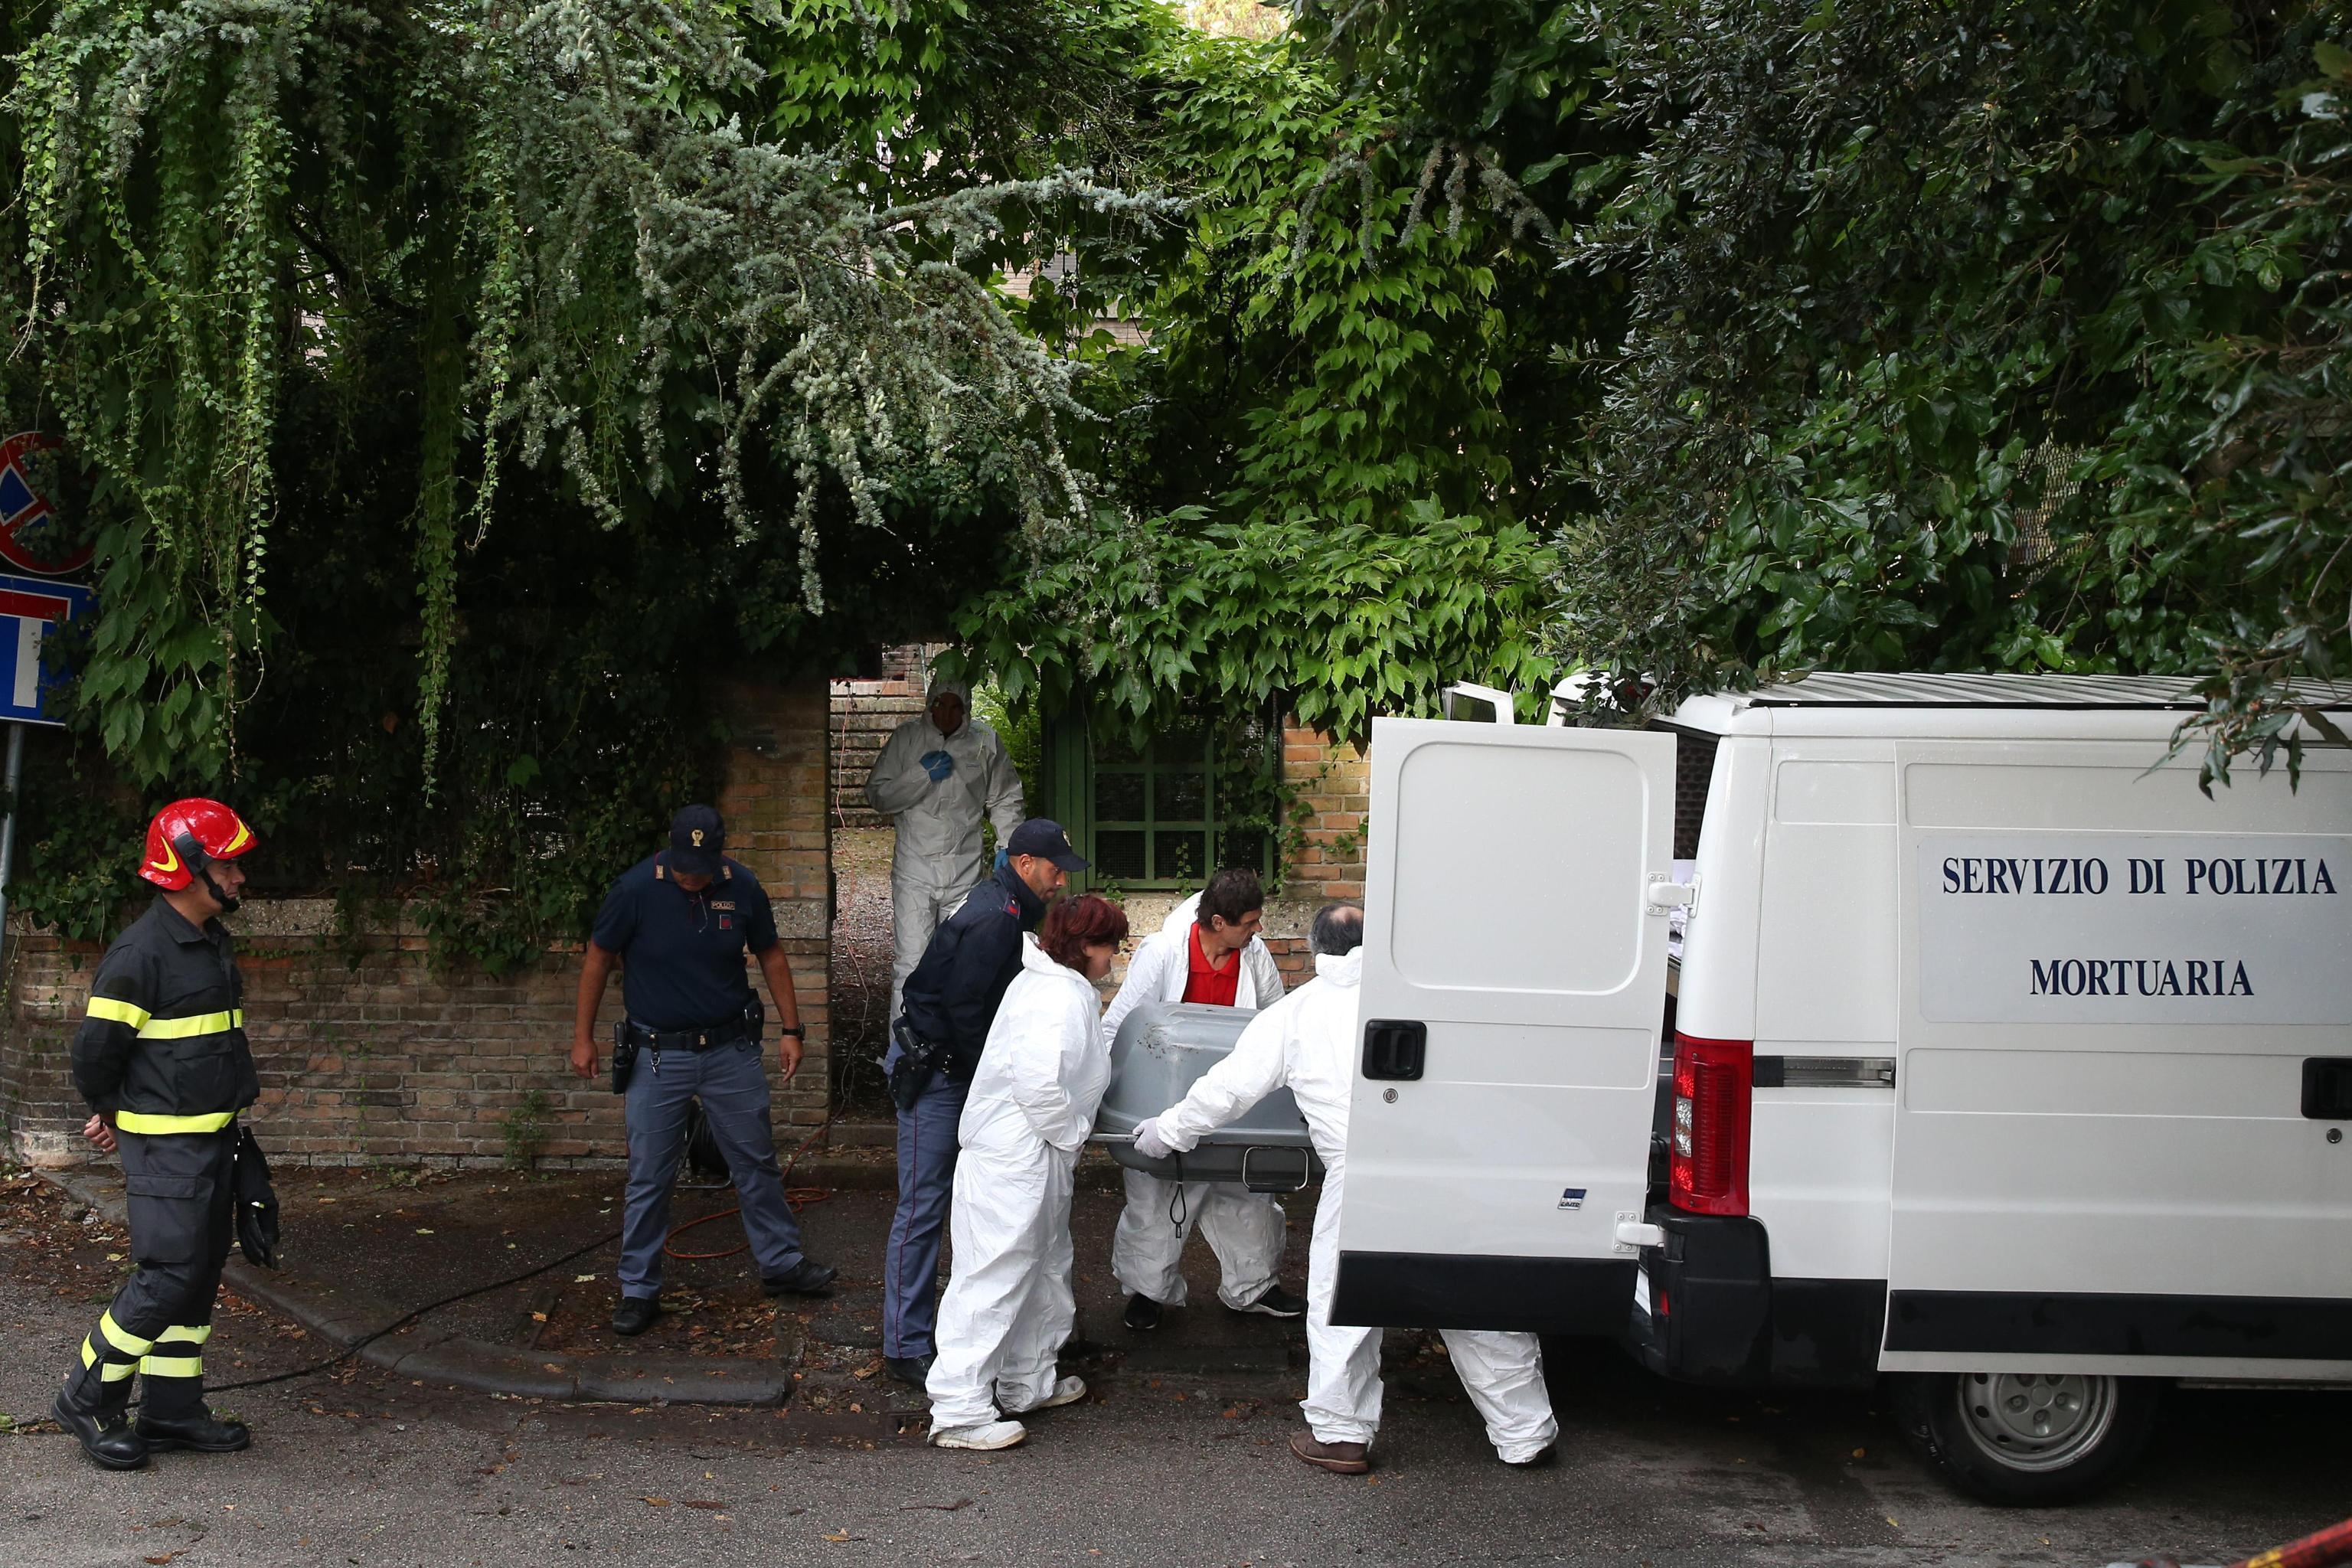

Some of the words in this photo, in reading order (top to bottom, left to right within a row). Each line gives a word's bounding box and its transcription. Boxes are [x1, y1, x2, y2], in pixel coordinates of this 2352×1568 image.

[1942, 857, 2109, 894] SERVIZIO
[2127, 858, 2167, 894] DI
[2185, 858, 2337, 895] POLIZIA
[2030, 959, 2255, 997] MORTUARIA
